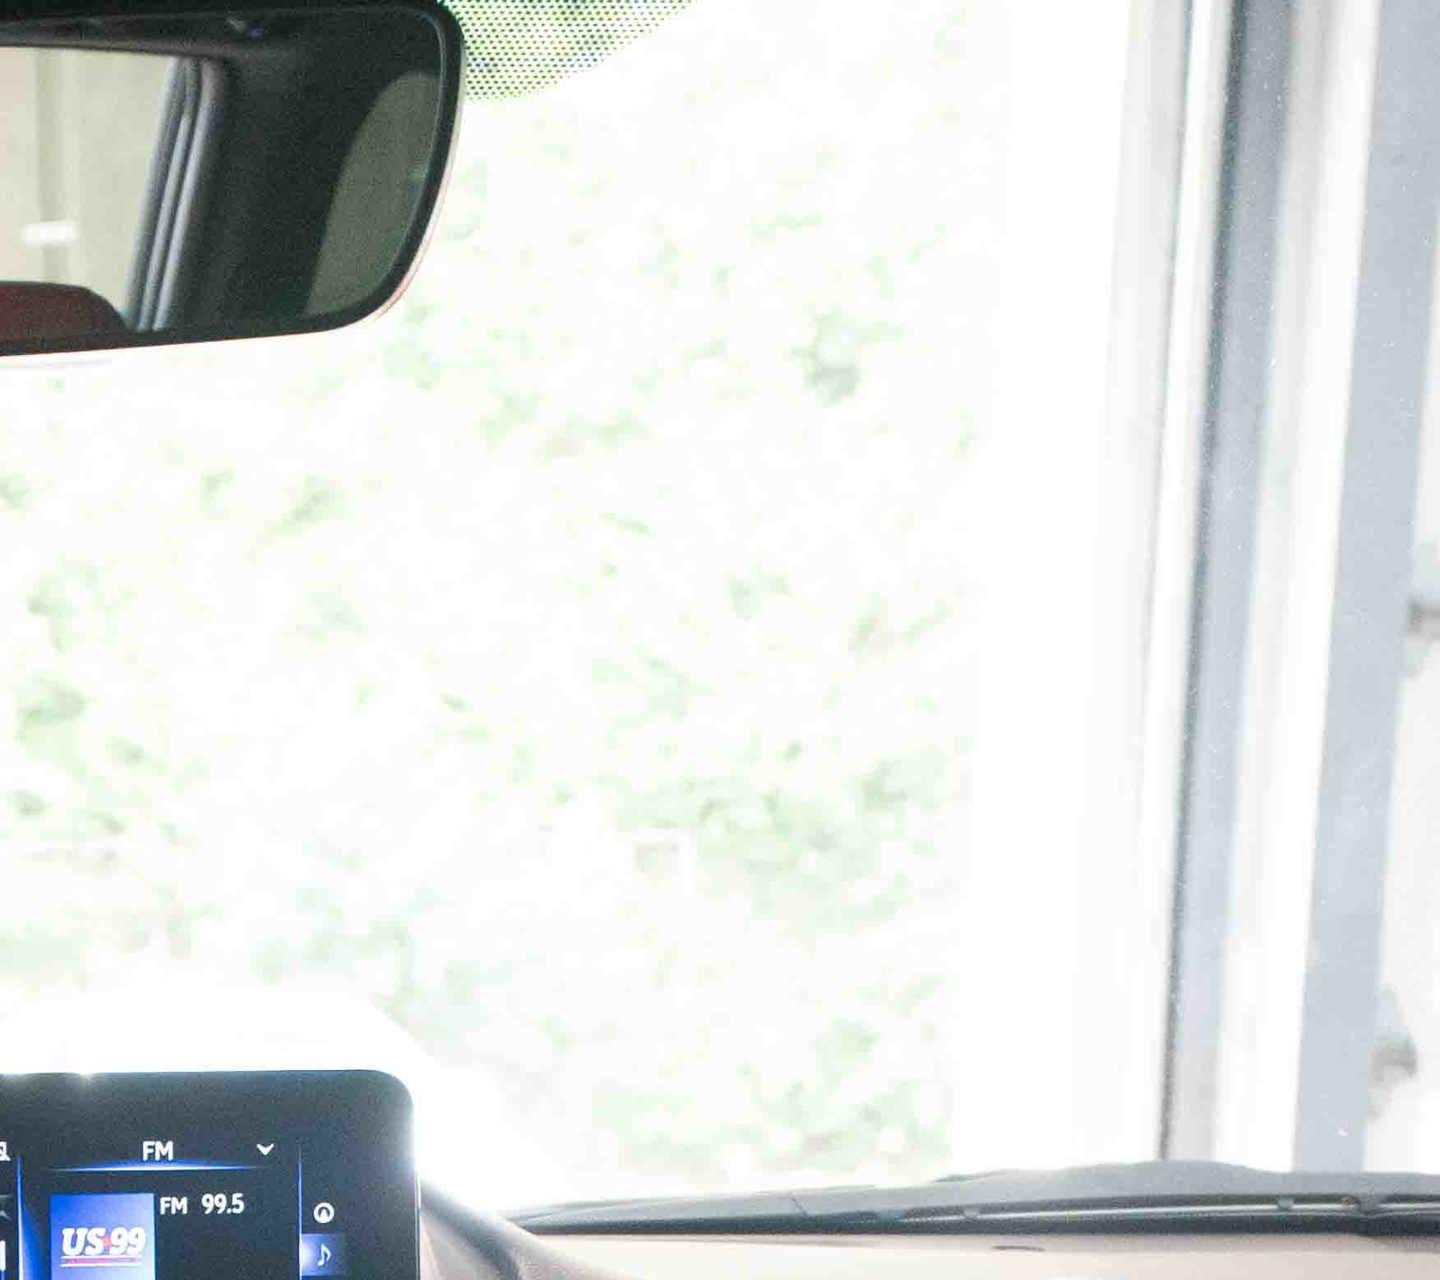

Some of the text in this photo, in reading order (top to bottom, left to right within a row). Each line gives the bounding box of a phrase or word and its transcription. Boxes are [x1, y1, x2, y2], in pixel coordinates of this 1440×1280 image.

[142, 1140, 174, 1162] FM
[159, 1192, 245, 1215] FM 99.5
